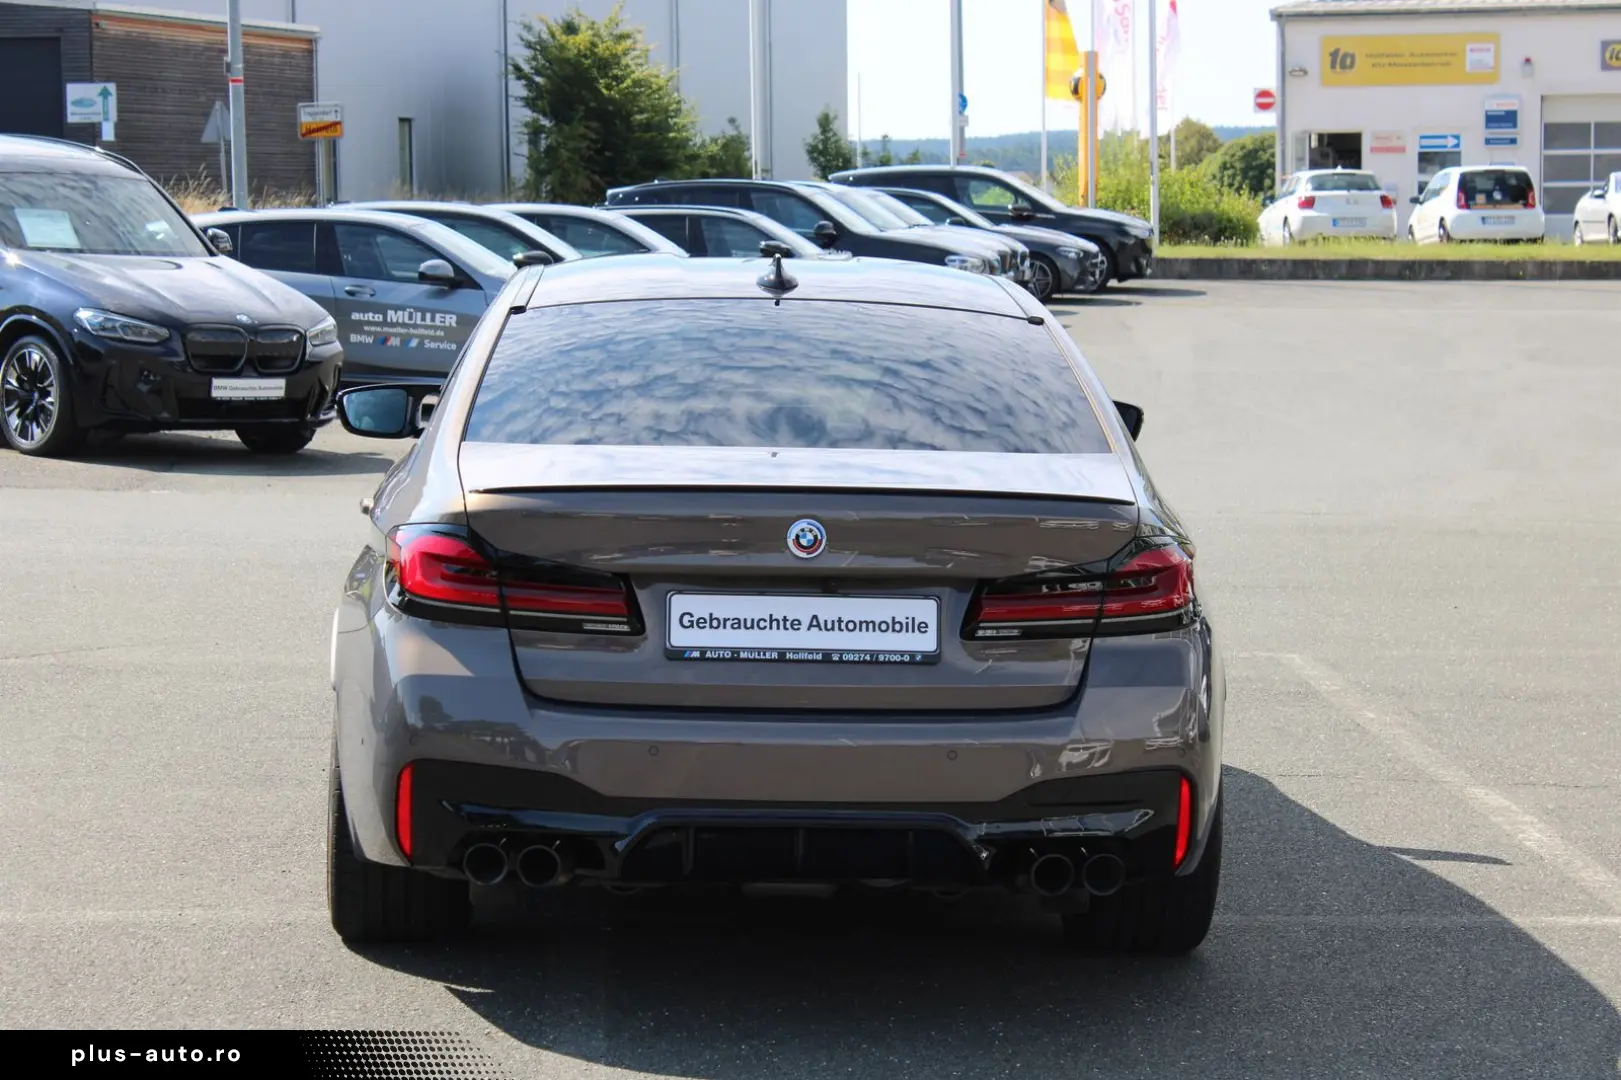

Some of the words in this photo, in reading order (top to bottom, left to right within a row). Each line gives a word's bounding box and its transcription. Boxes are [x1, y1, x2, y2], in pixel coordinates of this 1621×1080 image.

[351, 312, 383, 321] auto
[387, 308, 457, 327] MÜLLER
[350, 333, 374, 344] BMW
[424, 339, 457, 350] Service
[678, 611, 802, 631] Gebrauchte
[806, 614, 929, 634] Automobile
[705, 650, 731, 659] AUTO
[786, 651, 822, 660] Hollfeld
[842, 653, 871, 661] 09274
[878, 653, 910, 662] 9700-0
